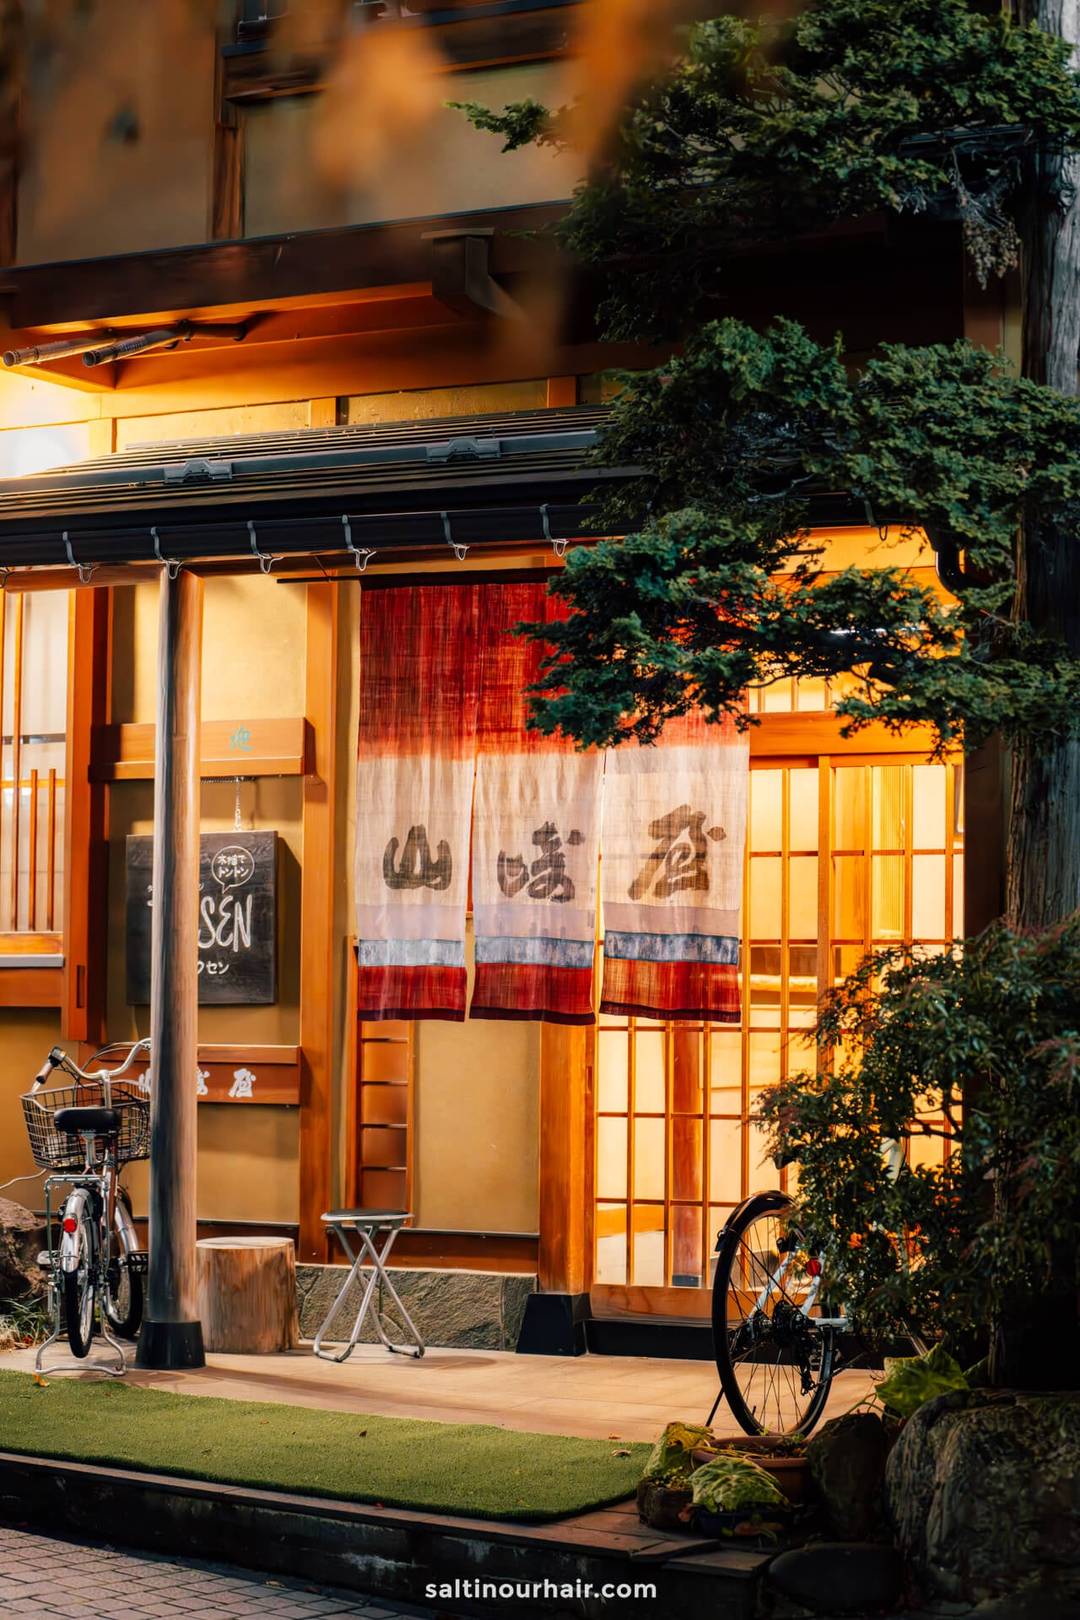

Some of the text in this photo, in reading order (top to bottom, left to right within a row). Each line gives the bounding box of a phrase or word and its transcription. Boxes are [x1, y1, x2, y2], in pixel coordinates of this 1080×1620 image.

[218, 866, 249, 879] トントン
[197, 894, 253, 953] SEN
